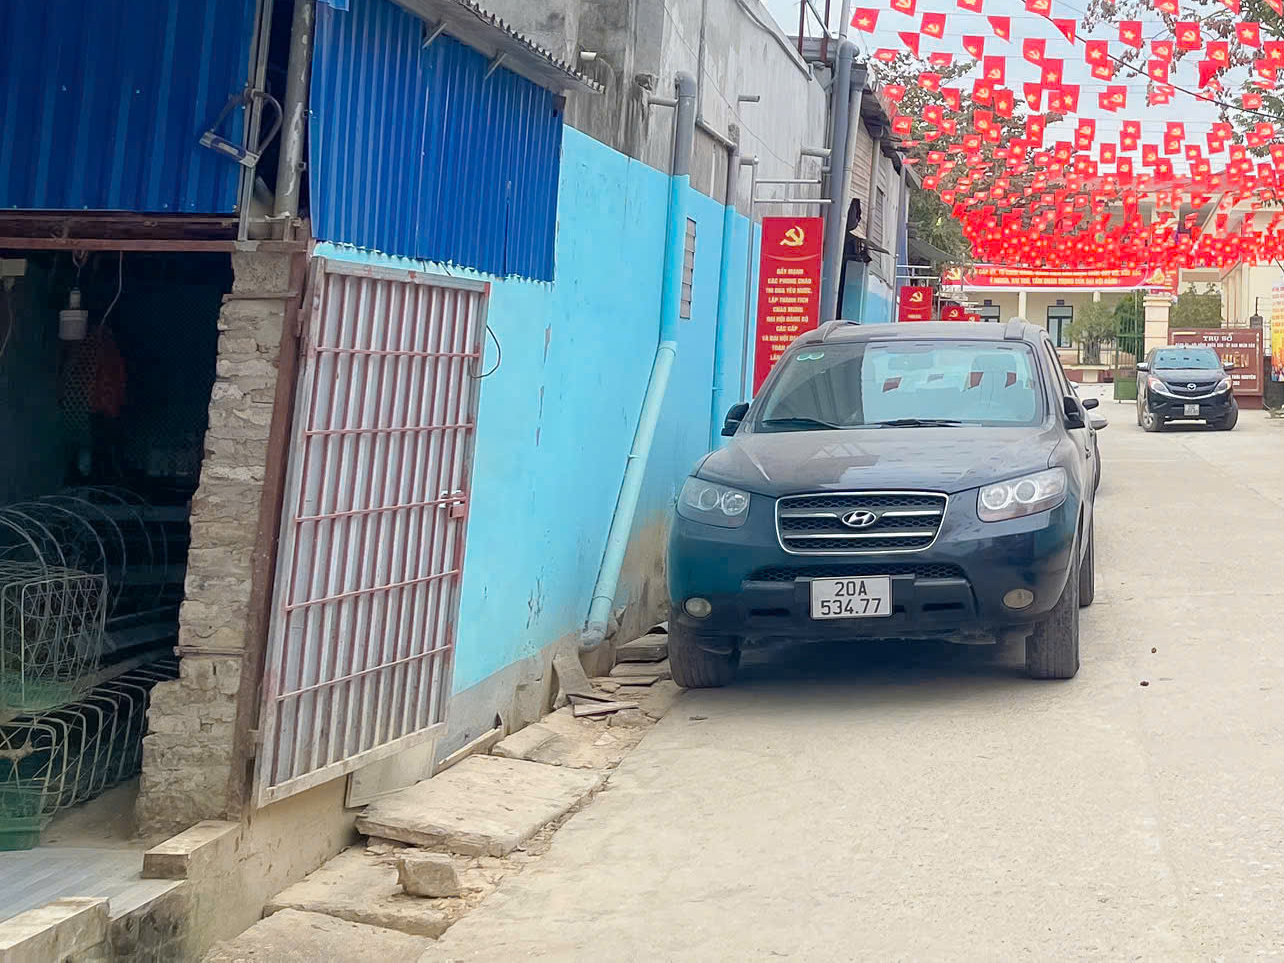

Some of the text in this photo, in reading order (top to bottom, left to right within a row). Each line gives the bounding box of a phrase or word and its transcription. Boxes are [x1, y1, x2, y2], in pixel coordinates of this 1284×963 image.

[1203, 332, 1233, 344] TRỤ SỞ
[834, 580, 867, 597] 20A
[821, 597, 882, 616] 534.77
